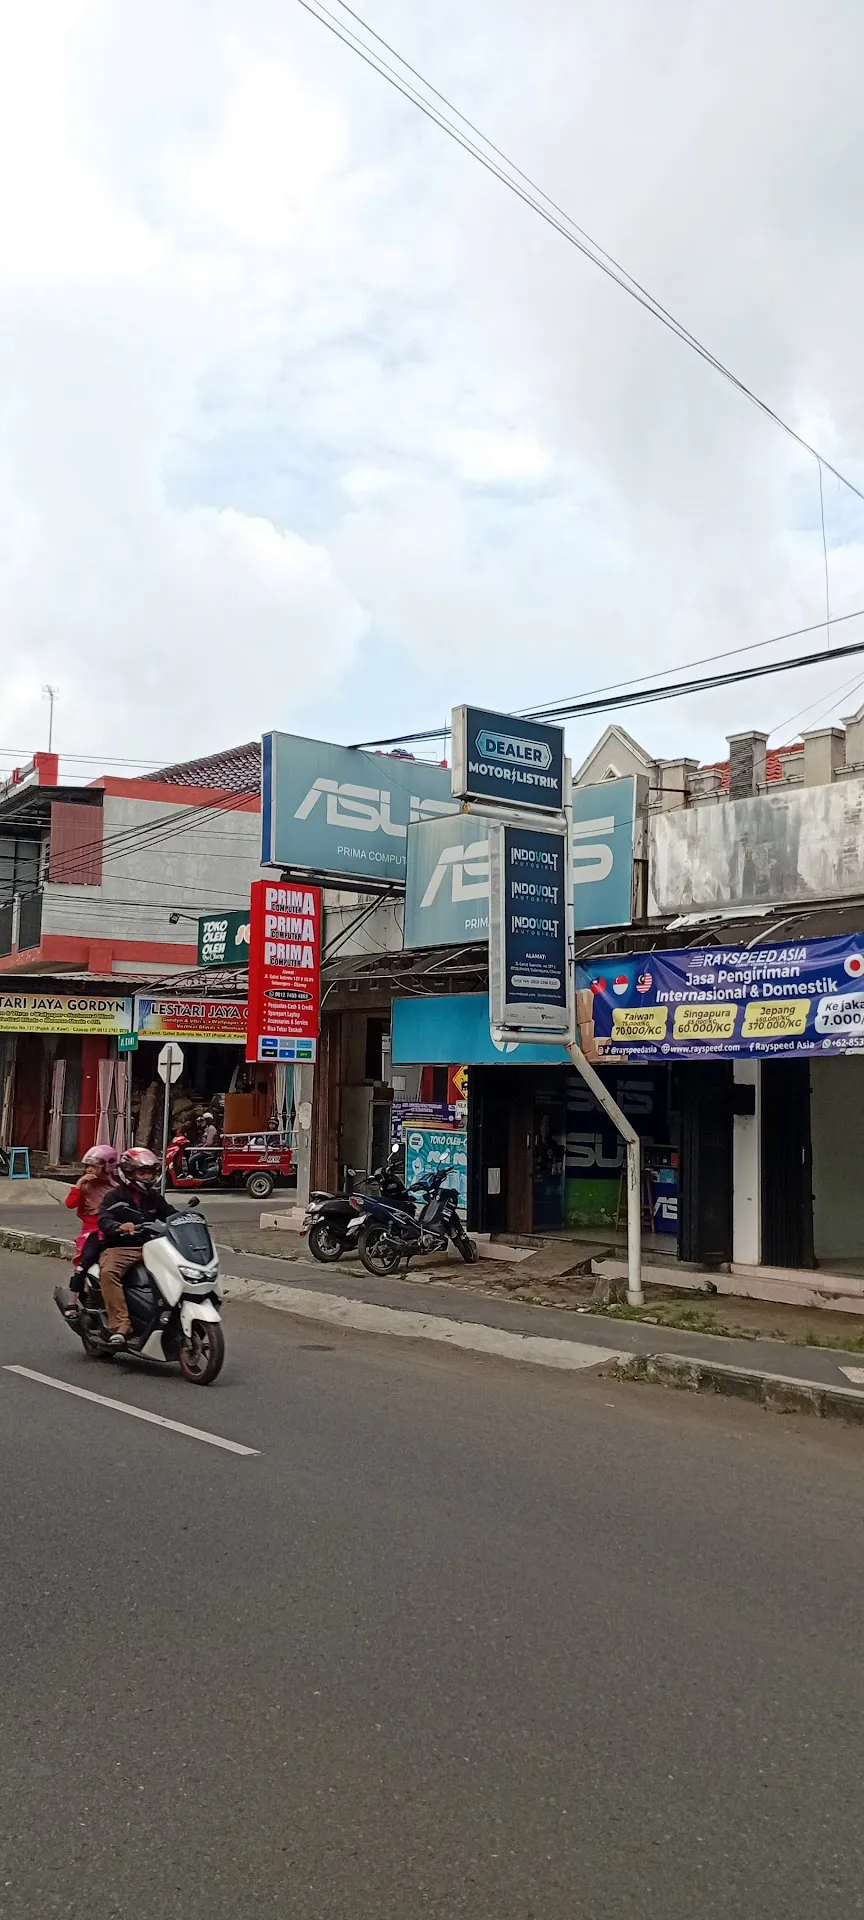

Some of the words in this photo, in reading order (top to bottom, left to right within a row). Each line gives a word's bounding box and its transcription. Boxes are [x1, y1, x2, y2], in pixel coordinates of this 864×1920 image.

[486, 739, 542, 762] DEALER
[469, 761, 511, 780] MOTOR
[517, 771, 558, 789] LISTRIK
[337, 845, 367, 859] PRIMA
[511, 847, 558, 871] INDOVOLT
[420, 816, 614, 908] ASS
[511, 881, 559, 904] INDOVOLT
[265, 887, 315, 916] PRIMA
[271, 904, 302, 913] COMPUTER
[203, 920, 228, 932] TOKO
[265, 914, 315, 942] PRIMA
[464, 917, 489, 930] PRIM
[511, 915, 559, 938] INDOVOLT
[203, 931, 227, 943] OLEH
[271, 931, 302, 940] COMPUTER
[202, 943, 226, 955] OLEH
[264, 941, 314, 969] PRIMA
[703, 949, 777, 967] RAYSPEED
[780, 947, 807, 961] ASIA
[686, 972, 715, 986] Jasa
[718, 966, 800, 985] Pengiriman
[656, 984, 746, 1003] Internasional
[750, 984, 759, 998] &
[763, 977, 838, 997] Domestik
[31, 998, 63, 1010] JAYA
[67, 999, 125, 1012] GORDYN
[151, 1003, 205, 1017] LESTARI
[208, 1005, 241, 1019] JAYA
[760, 1006, 796, 1017] Jepang
[825, 1002, 839, 1012] Ke
[624, 1012, 654, 1021] Taiwan
[683, 1009, 731, 1021] Singapura
[615, 1026, 662, 1036] 70.000/KG
[678, 1022, 731, 1034] 60.000/KG
[747, 1019, 801, 1031] 370.000/KG
[611, 1045, 657, 1055] @rayspeedasia
[670, 1043, 740, 1053] www.rayspeed.com
[755, 1041, 794, 1052] Rayspeed
[796, 1040, 815, 1049] Asia
[430, 1135, 446, 1145] TOKO
